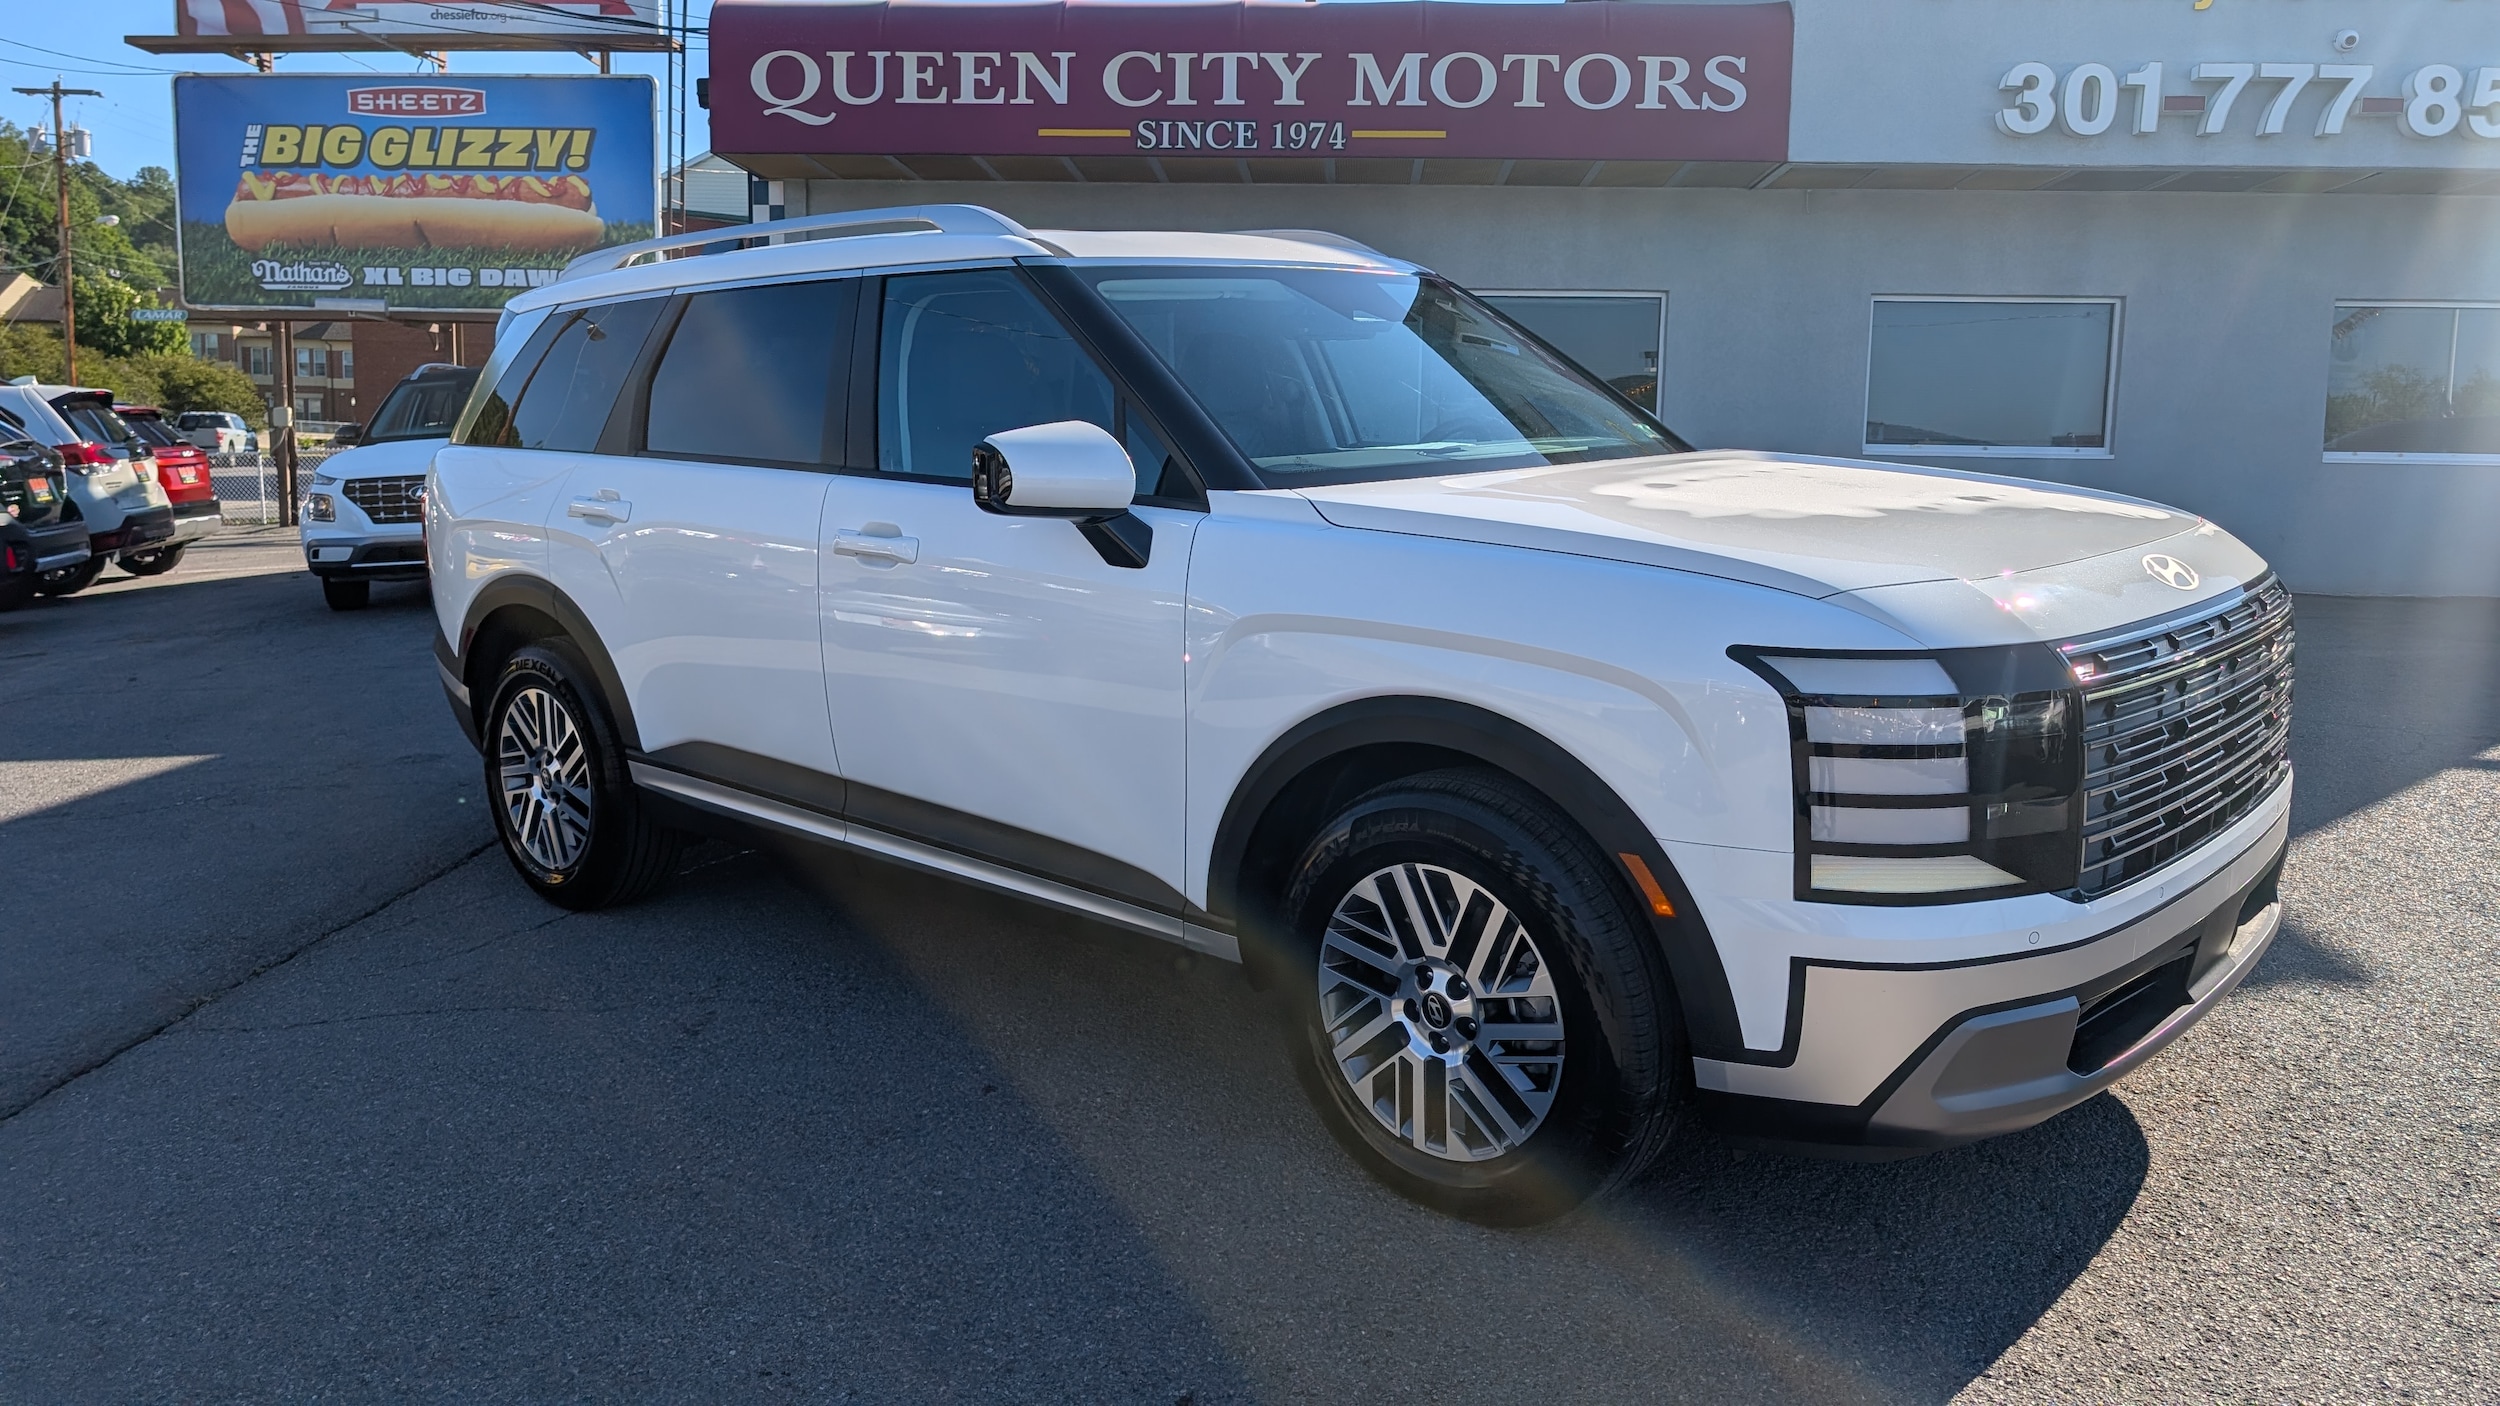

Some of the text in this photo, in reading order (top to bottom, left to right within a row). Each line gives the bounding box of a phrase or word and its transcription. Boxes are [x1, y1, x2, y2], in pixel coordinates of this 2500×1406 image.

[430, 8, 507, 24] chessiefcu.org
[749, 49, 1748, 126] QUEEN CITY MOTORS
[356, 93, 477, 111] SHEETZ
[240, 123, 593, 169] THE BIG GLIZZY!
[1136, 120, 1347, 151] SINCE 1974
[251, 259, 354, 283] Nathan's
[362, 266, 564, 288] XL BIG DAW
[135, 310, 183, 320] LAMAR
[515, 658, 558, 682] NEXEN
